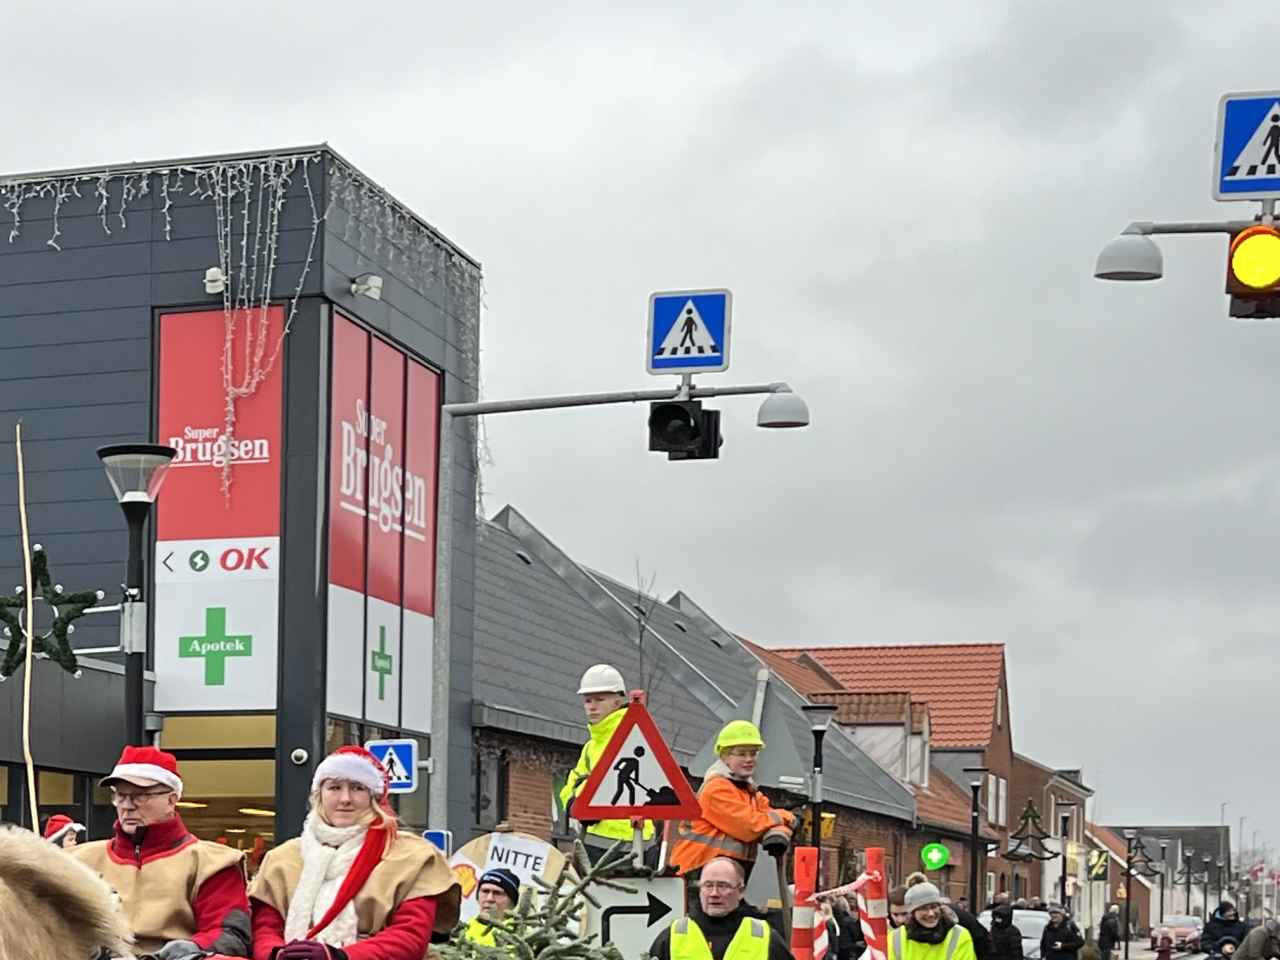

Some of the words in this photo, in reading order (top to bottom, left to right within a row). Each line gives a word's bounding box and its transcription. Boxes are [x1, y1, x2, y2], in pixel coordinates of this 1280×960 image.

[183, 426, 220, 441] Super
[169, 434, 271, 467] Brugsen
[220, 547, 271, 571] OK
[189, 640, 245, 655] Apotek
[490, 845, 544, 872] NITTE
